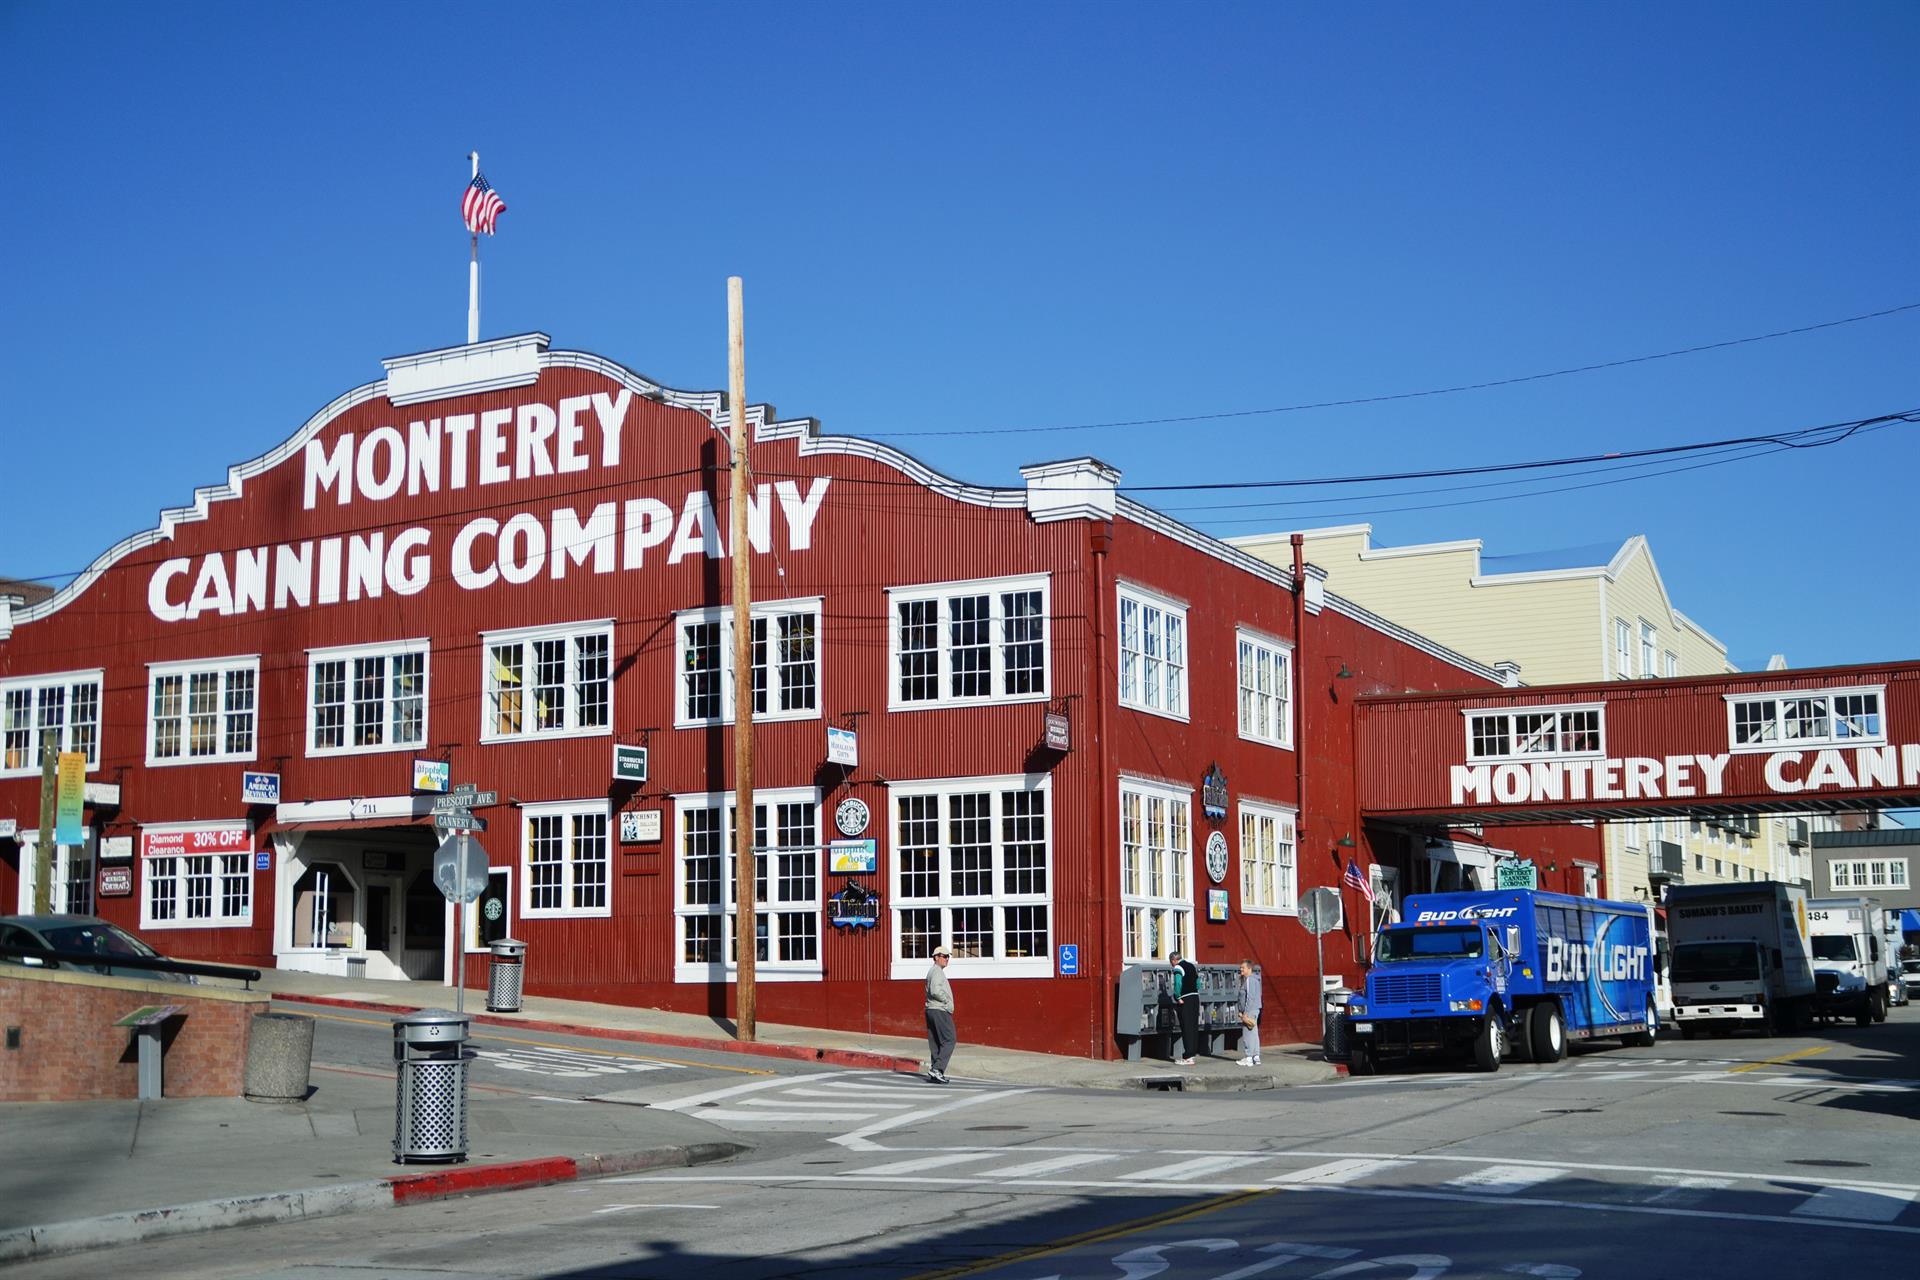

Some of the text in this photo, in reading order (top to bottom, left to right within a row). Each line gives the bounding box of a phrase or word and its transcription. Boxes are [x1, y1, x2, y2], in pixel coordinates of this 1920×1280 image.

[303, 389, 633, 510] MONTEREY
[148, 477, 832, 621] CANNING COMPANY
[619, 756, 644, 764] STARBUCKS
[1450, 754, 1731, 806] MONTEREY
[437, 793, 494, 808] PRESCOTT AVE.
[362, 804, 377, 814] 711
[438, 815, 470, 828] CANNERY
[623, 812, 658, 824] ZCHINI'S
[150, 830, 243, 847] Diamond 30% OFF
[148, 845, 185, 855] Clearance
[1727, 903, 1764, 915] BAKERY
[1417, 911, 1458, 922] BUD
[1546, 937, 1648, 982] BUD LIGHT
